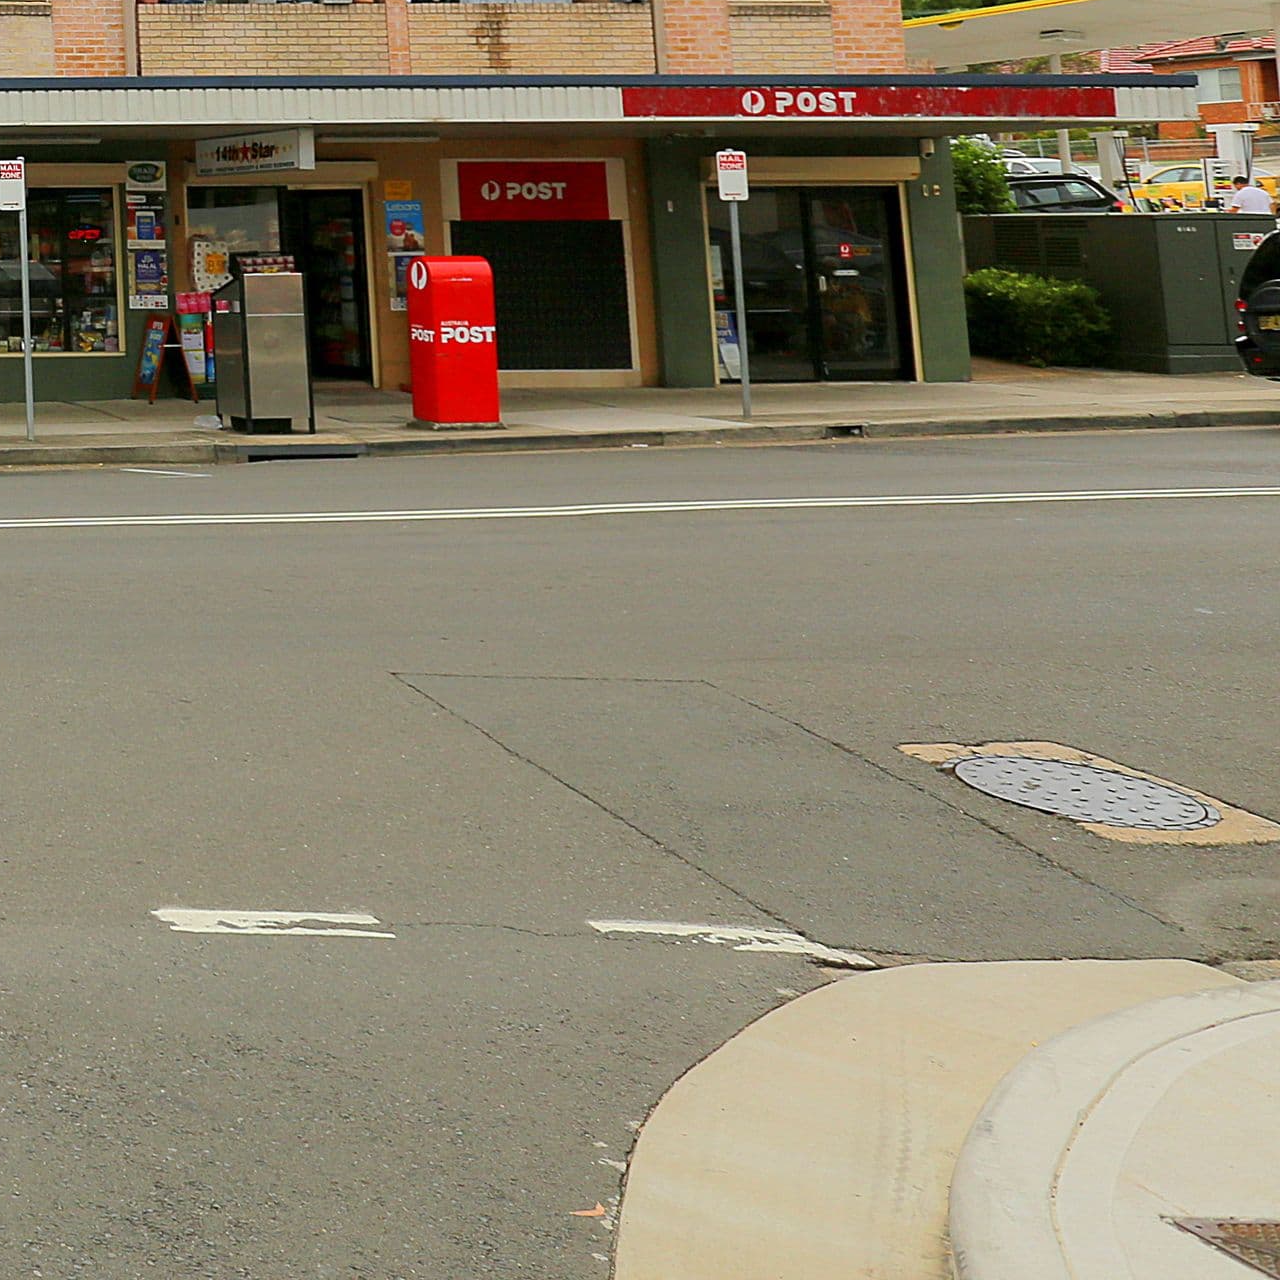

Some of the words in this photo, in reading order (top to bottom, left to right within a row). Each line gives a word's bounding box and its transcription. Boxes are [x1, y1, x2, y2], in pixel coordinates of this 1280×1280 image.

[775, 91, 857, 113] POST
[506, 182, 567, 200] POST
[411, 328, 435, 342] POST
[441, 326, 496, 343] POST
